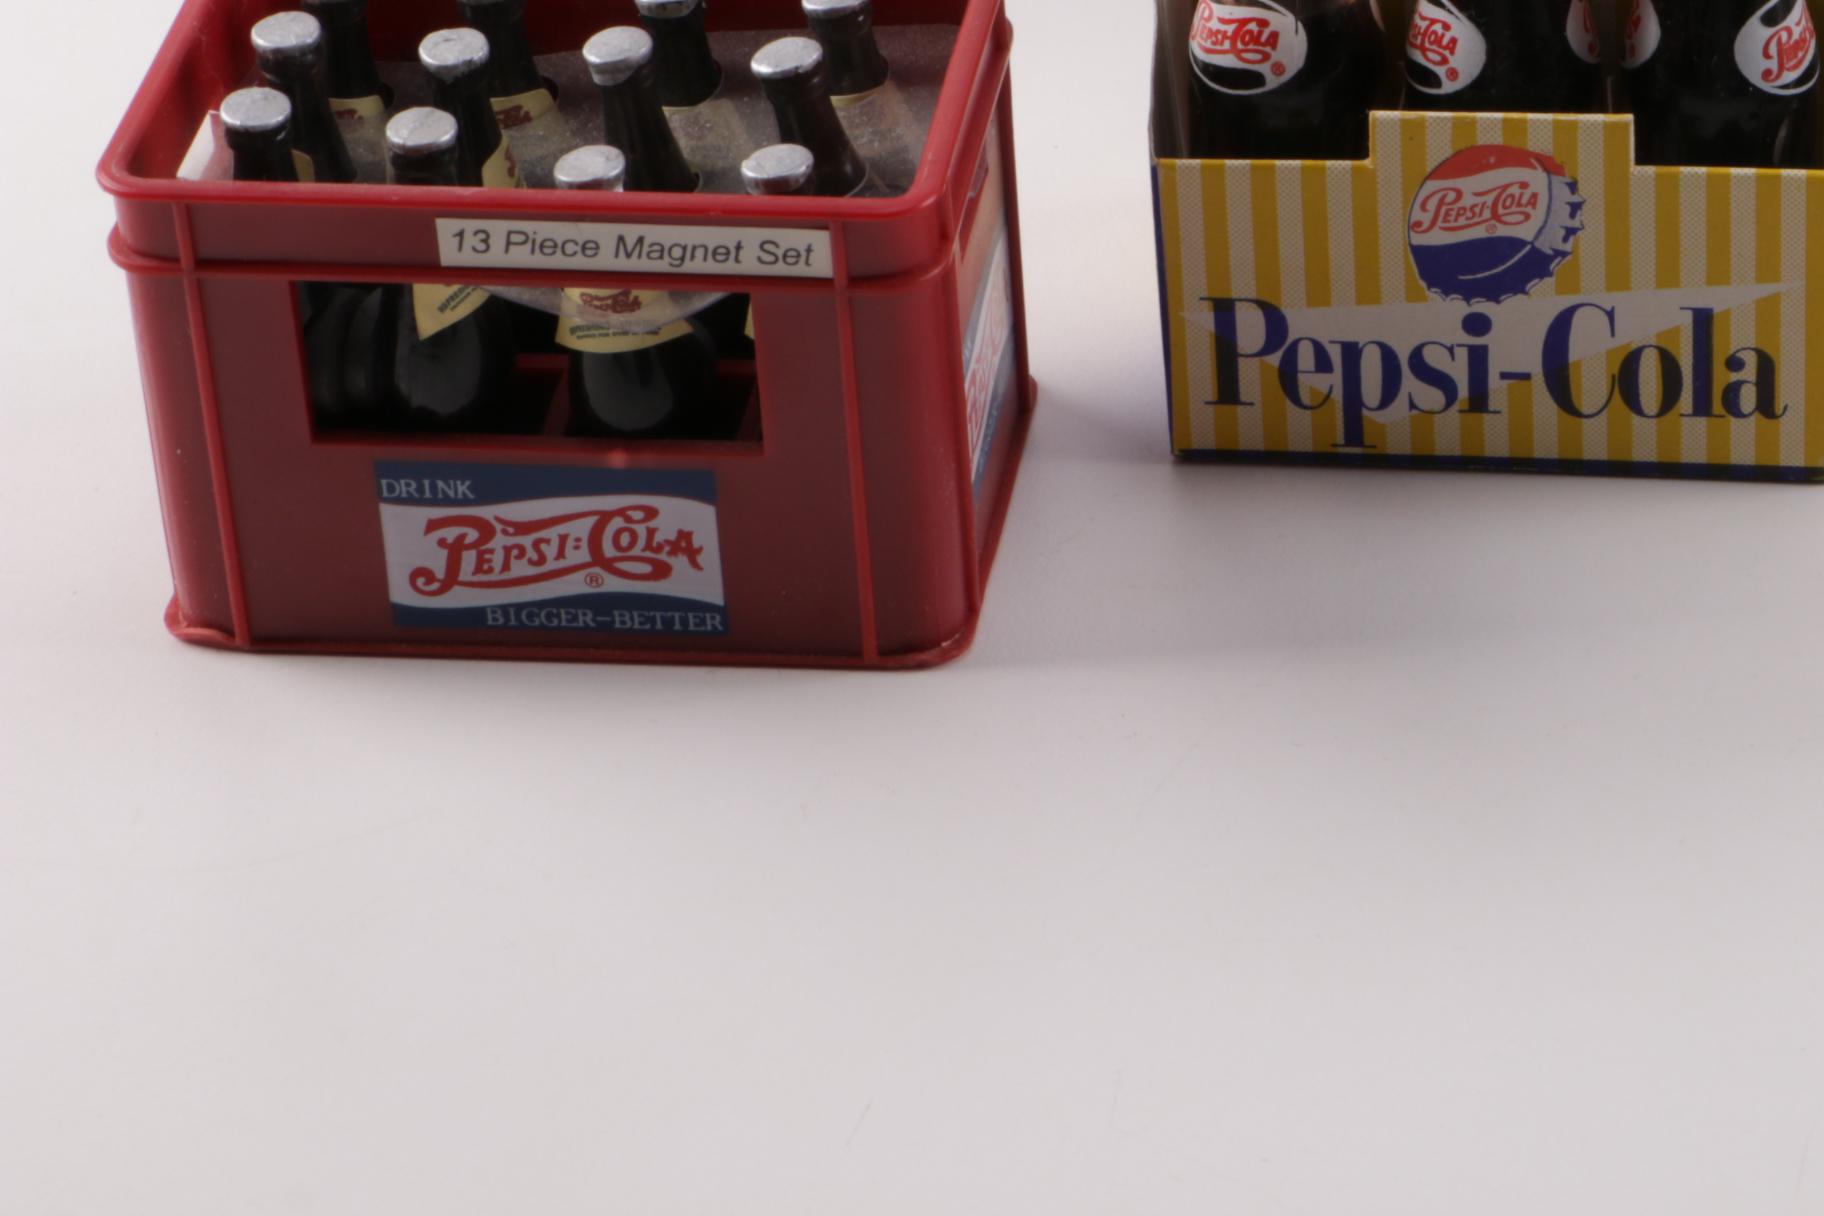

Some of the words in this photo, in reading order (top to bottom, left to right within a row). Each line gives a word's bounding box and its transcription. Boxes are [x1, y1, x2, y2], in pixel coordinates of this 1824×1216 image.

[451, 228, 491, 254] 13
[504, 230, 601, 259] Piece
[614, 233, 745, 268] Magnet
[756, 239, 815, 267] Set
[1199, 296, 1789, 449] Pepsi-Cola
[380, 478, 476, 500] DRINK
[486, 605, 724, 632] BIGGER-BETTER
